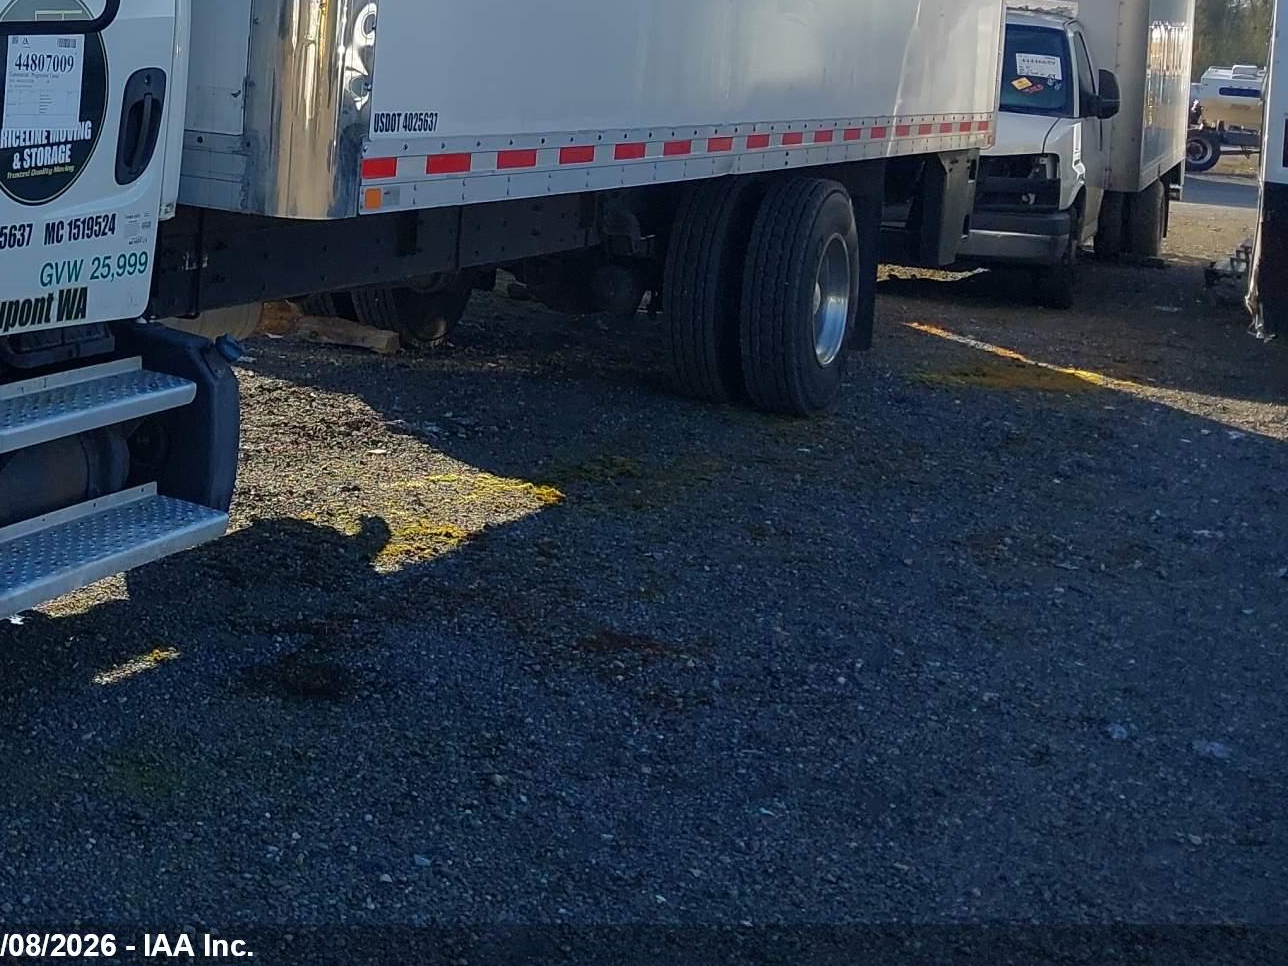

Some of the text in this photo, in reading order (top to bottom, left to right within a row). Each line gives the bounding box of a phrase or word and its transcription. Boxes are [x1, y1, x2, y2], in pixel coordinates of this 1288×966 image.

[14, 52, 74, 74] 44807009
[373, 112, 439, 133] USDOT 4025637
[12, 143, 72, 170] & STORAGE
[43, 220, 65, 246] MC
[67, 213, 116, 242] 1519524
[40, 251, 149, 287] GVW 25,999
[56, 287, 88, 322] WA
